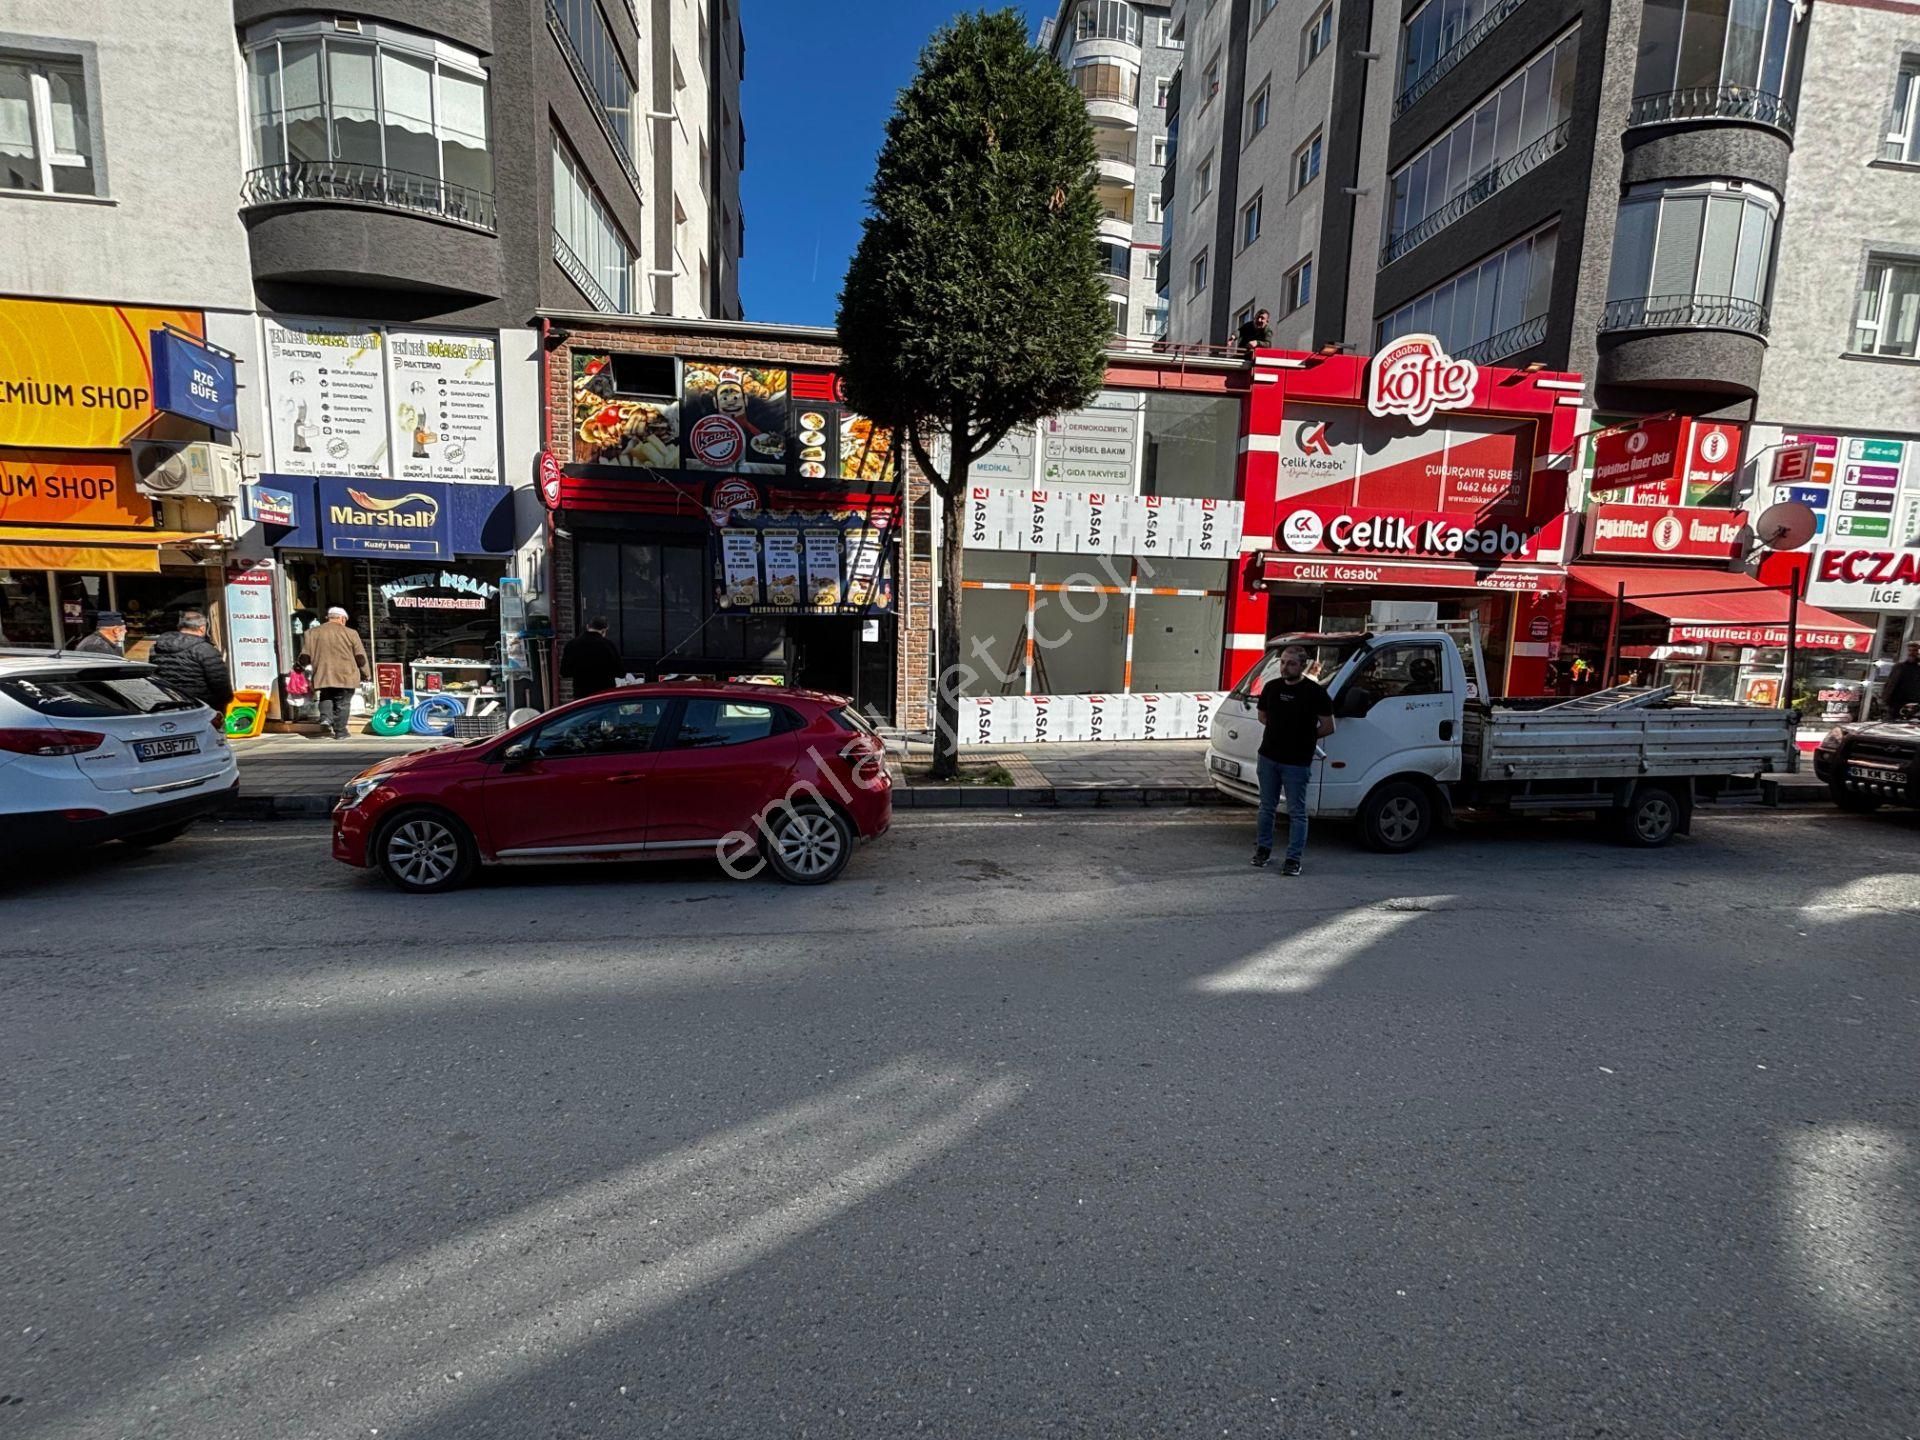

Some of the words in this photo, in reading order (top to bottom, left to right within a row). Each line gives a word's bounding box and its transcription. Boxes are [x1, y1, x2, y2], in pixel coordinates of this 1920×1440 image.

[1383, 344, 1424, 370] akçaabat
[193, 369, 215, 388] RZG
[1377, 355, 1464, 409] köfte
[81, 385, 149, 410] SHOP
[190, 383, 219, 403] BÜFE
[1069, 424, 1128, 433] DERMOKOZMETİK
[1069, 445, 1099, 454] KİŞİSEL
[1101, 447, 1126, 455] BAKIM
[976, 463, 1011, 472] MEDİKAL
[1281, 457, 1307, 468] Çelik
[1310, 458, 1343, 470] Kasabı
[1630, 455, 1652, 471] Ömer
[1652, 452, 1671, 466] Usta
[1066, 468, 1086, 477] GIDA
[1087, 470, 1127, 478] TAKVİYESİ
[1487, 469, 1523, 481] ŞUBESİ
[44, 476, 115, 500] SHOP
[1457, 481, 1479, 492] 0462
[1481, 484, 1498, 493] 666
[1801, 493, 1817, 503] İLAÇ
[330, 506, 429, 528] Marshall
[972, 502, 986, 542] ASAŞ
[1030, 504, 1044, 545] ASAŞ
[1087, 507, 1102, 547] ASAŞ
[1144, 510, 1158, 549] ASAŞ
[1200, 512, 1215, 551] ASAŞ
[1330, 515, 1416, 552] Çelik
[1424, 520, 1530, 555] Kasabı
[1689, 519, 1719, 542] Ömer
[364, 541, 387, 549] Kuzey
[388, 541, 411, 550] İnşaat
[1294, 565, 1328, 580] Çelik
[1334, 566, 1378, 580] Kasabı
[1816, 550, 1920, 585] ECZA
[381, 573, 435, 599] KUZEY
[440, 570, 500, 600] İNŞAAT
[1499, 580, 1515, 588] 666
[1527, 581, 1537, 589] 10
[418, 597, 486, 610] MALZEMELERİ
[1870, 587, 1901, 603] İLGE
[1764, 629, 1801, 643] Ömr
[1806, 633, 1839, 646] Usta
